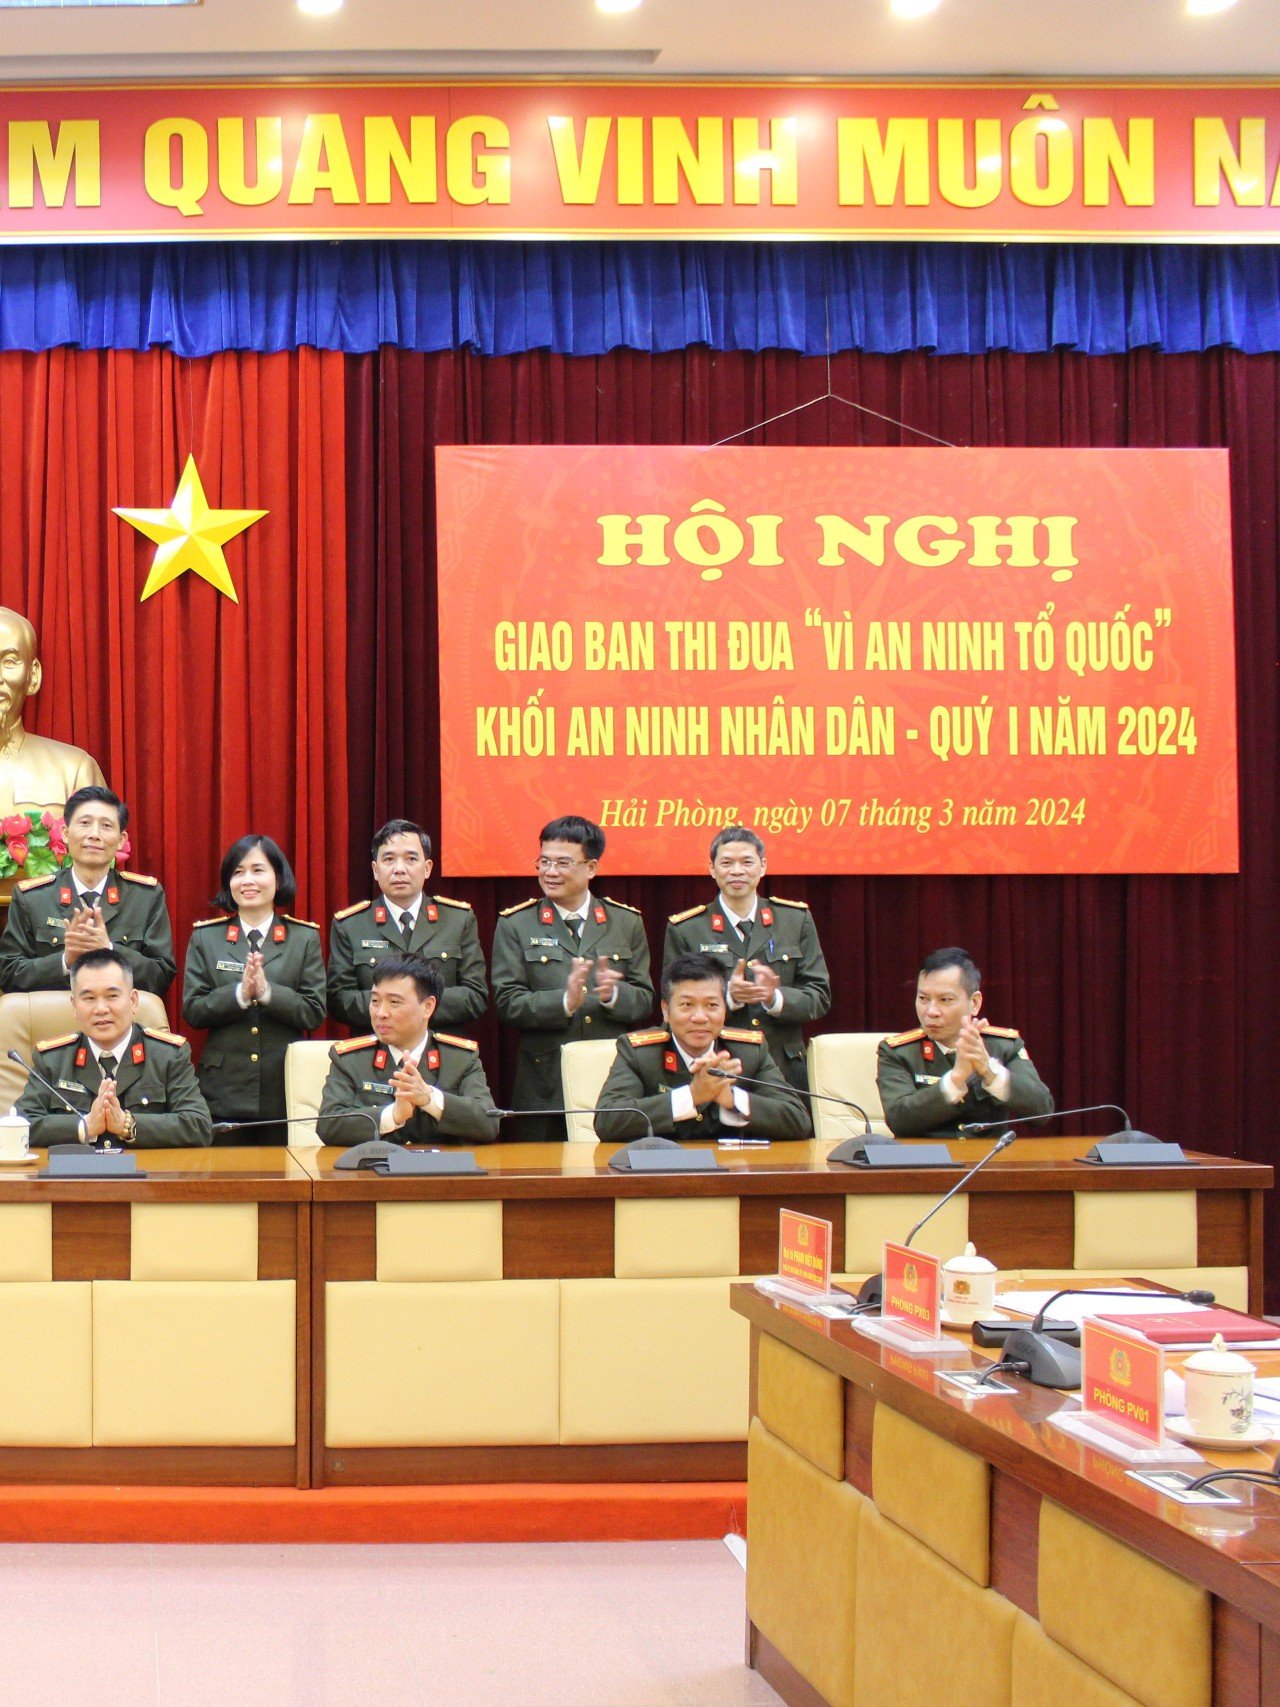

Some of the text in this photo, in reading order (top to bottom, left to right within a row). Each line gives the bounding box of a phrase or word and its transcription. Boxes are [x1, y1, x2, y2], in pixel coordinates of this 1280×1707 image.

[144, 113, 511, 217] QUANG
[547, 116, 798, 206] VINH
[838, 93, 1155, 208] MUÔN
[1194, 117, 1280, 207] N
[596, 498, 1080, 583] HỘI NGHỊ
[494, 601, 1172, 677] GIAO BAN THI ĐUA “VÌ AN NINH TỔ QUỐC”
[476, 688, 556, 757] KHỐI
[566, 706, 614, 756] AN
[626, 706, 709, 756] NINH
[721, 695, 815, 756] NHÂN
[826, 695, 895, 756] DÂN
[929, 695, 994, 762] QUÝ
[1008, 706, 1019, 756] I
[1029, 695, 1107, 756] NĂM
[1117, 706, 1198, 757] 2024
[598, 797, 648, 827] Hải
[753, 798, 813, 834] ngày
[821, 798, 852, 827] 07
[859, 797, 933, 834] tháng
[939, 798, 954, 827] 3
[962, 798, 1017, 827] năm
[1025, 797, 1087, 827] 2024
[1093, 1387, 1150, 1424] PHÒNG PV01
